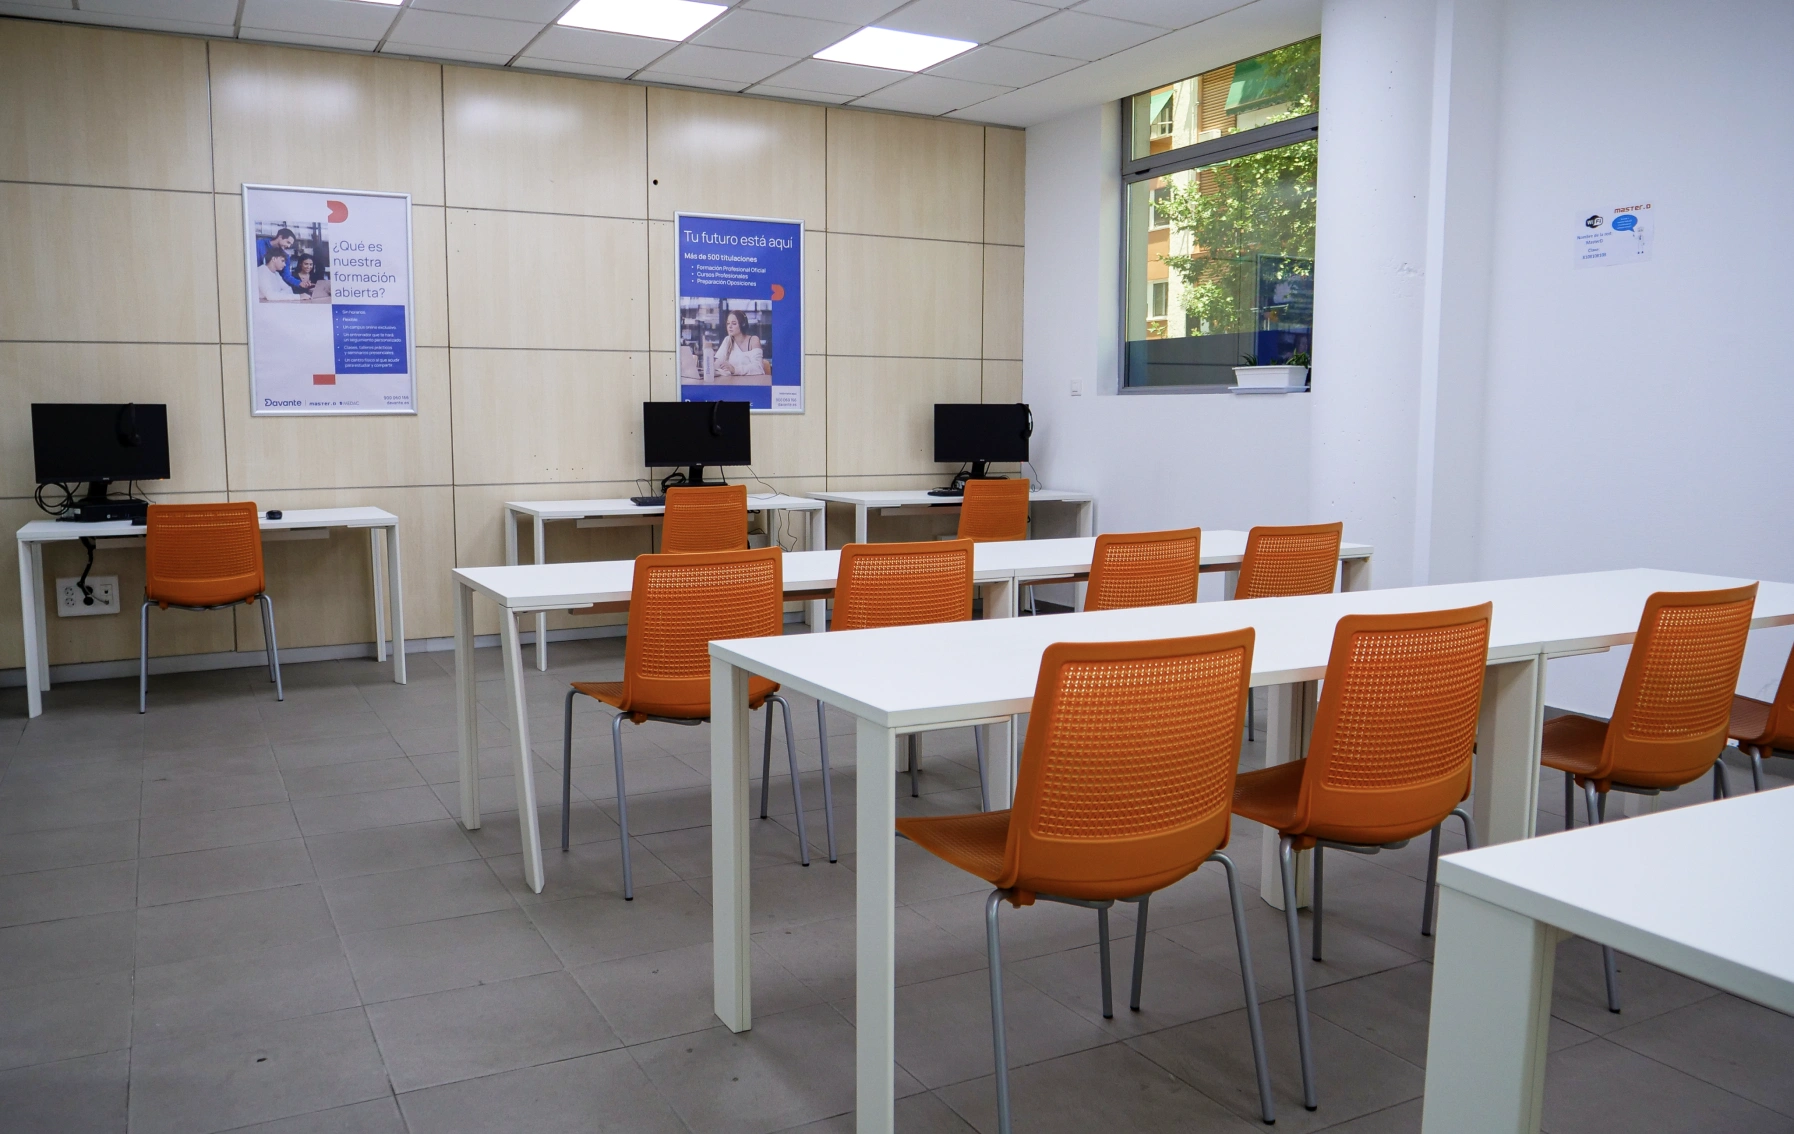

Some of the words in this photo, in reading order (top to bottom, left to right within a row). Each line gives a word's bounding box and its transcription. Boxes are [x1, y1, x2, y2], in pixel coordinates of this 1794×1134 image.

[684, 230, 699, 243] Tu
[702, 232, 738, 246] futuro
[740, 235, 766, 247] está
[768, 236, 793, 251] aquí
[333, 240, 365, 254] ¿Qué
[368, 243, 383, 252] es
[333, 256, 382, 268] nuestra
[720, 254, 758, 262] titulaciones
[334, 271, 396, 283] formación
[334, 287, 386, 298] abierta?
[264, 398, 302, 407] Davante
